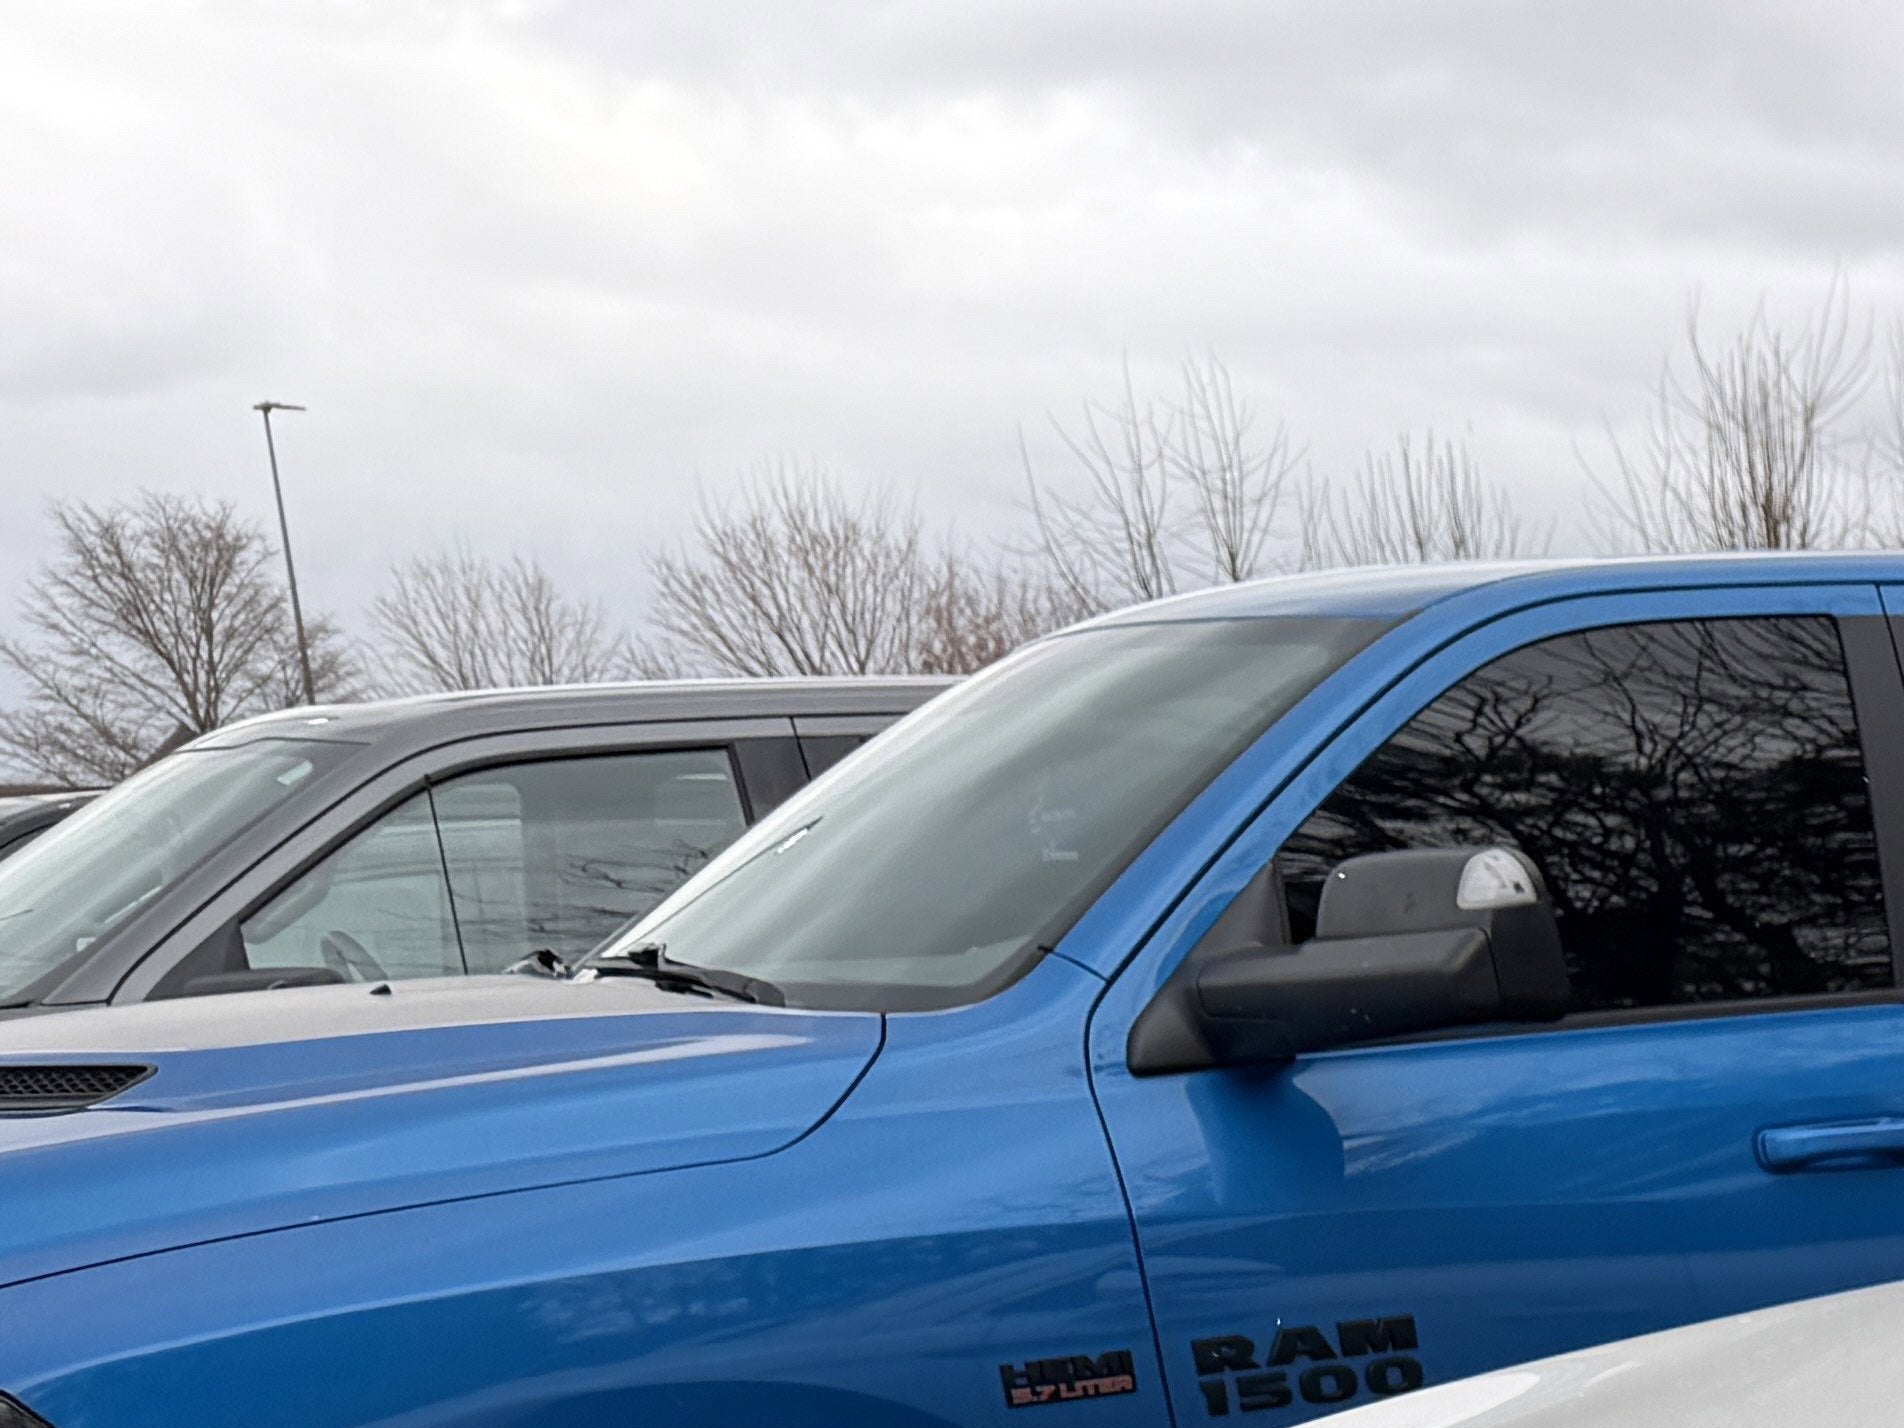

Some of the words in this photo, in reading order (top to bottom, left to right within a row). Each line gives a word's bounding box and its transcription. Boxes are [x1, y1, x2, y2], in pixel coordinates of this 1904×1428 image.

[999, 1350, 1133, 1386] HEMI
[1190, 1315, 1418, 1374] RAM
[1057, 1374, 1134, 1400] LITER
[1199, 1355, 1425, 1417] 1500
